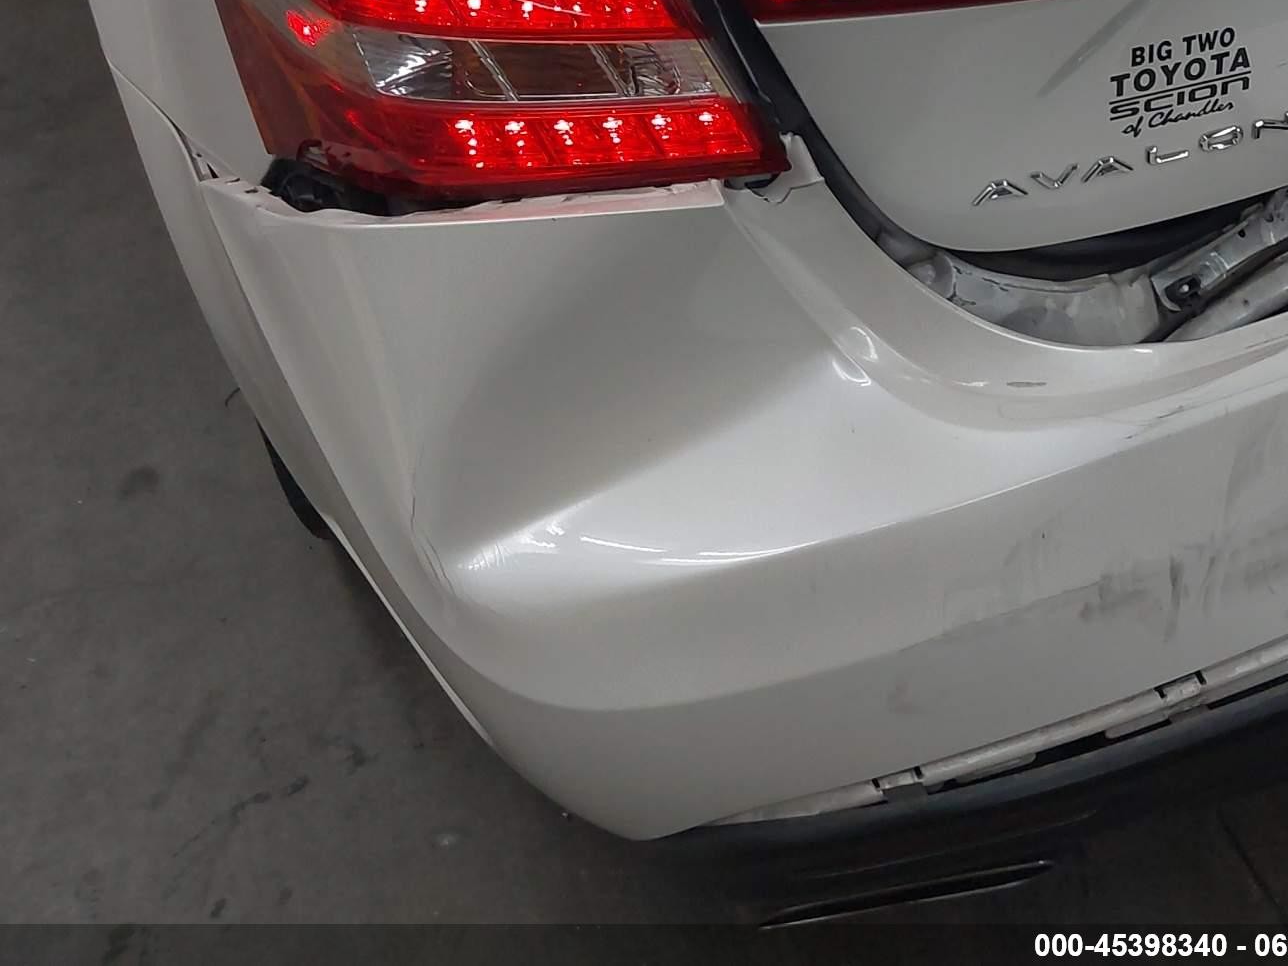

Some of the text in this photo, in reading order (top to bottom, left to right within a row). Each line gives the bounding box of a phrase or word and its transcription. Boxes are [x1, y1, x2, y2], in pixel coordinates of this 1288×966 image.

[1130, 26, 1236, 68] BIG TWO
[1110, 47, 1251, 97] TOYOTA
[1121, 98, 1234, 138] of Chandler
